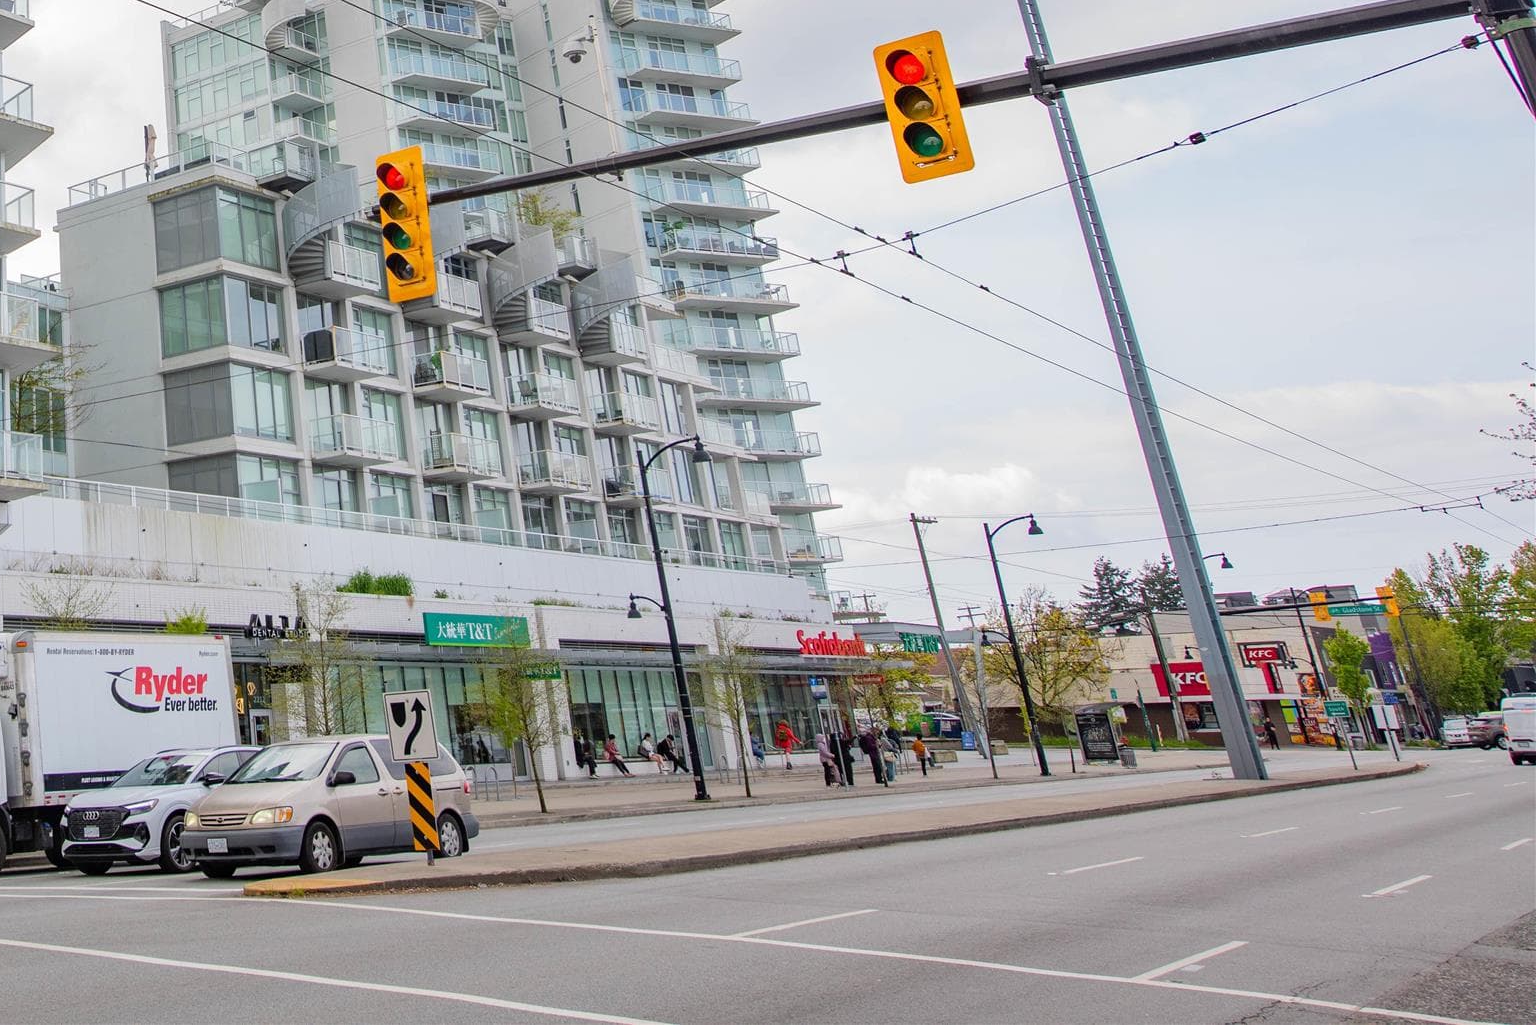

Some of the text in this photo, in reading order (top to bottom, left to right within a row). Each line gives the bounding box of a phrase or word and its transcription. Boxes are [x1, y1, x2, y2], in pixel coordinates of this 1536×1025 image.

[249, 614, 307, 630] ALTA
[252, 628, 280, 638] DENTAL
[437, 622, 466, 639] 大統華
[466, 622, 493, 640] T&T
[796, 630, 866, 656] Scotiabank
[1249, 649, 1273, 658] KFC
[135, 666, 208, 702] Ryder
[165, 697, 218, 712] Ever better.
